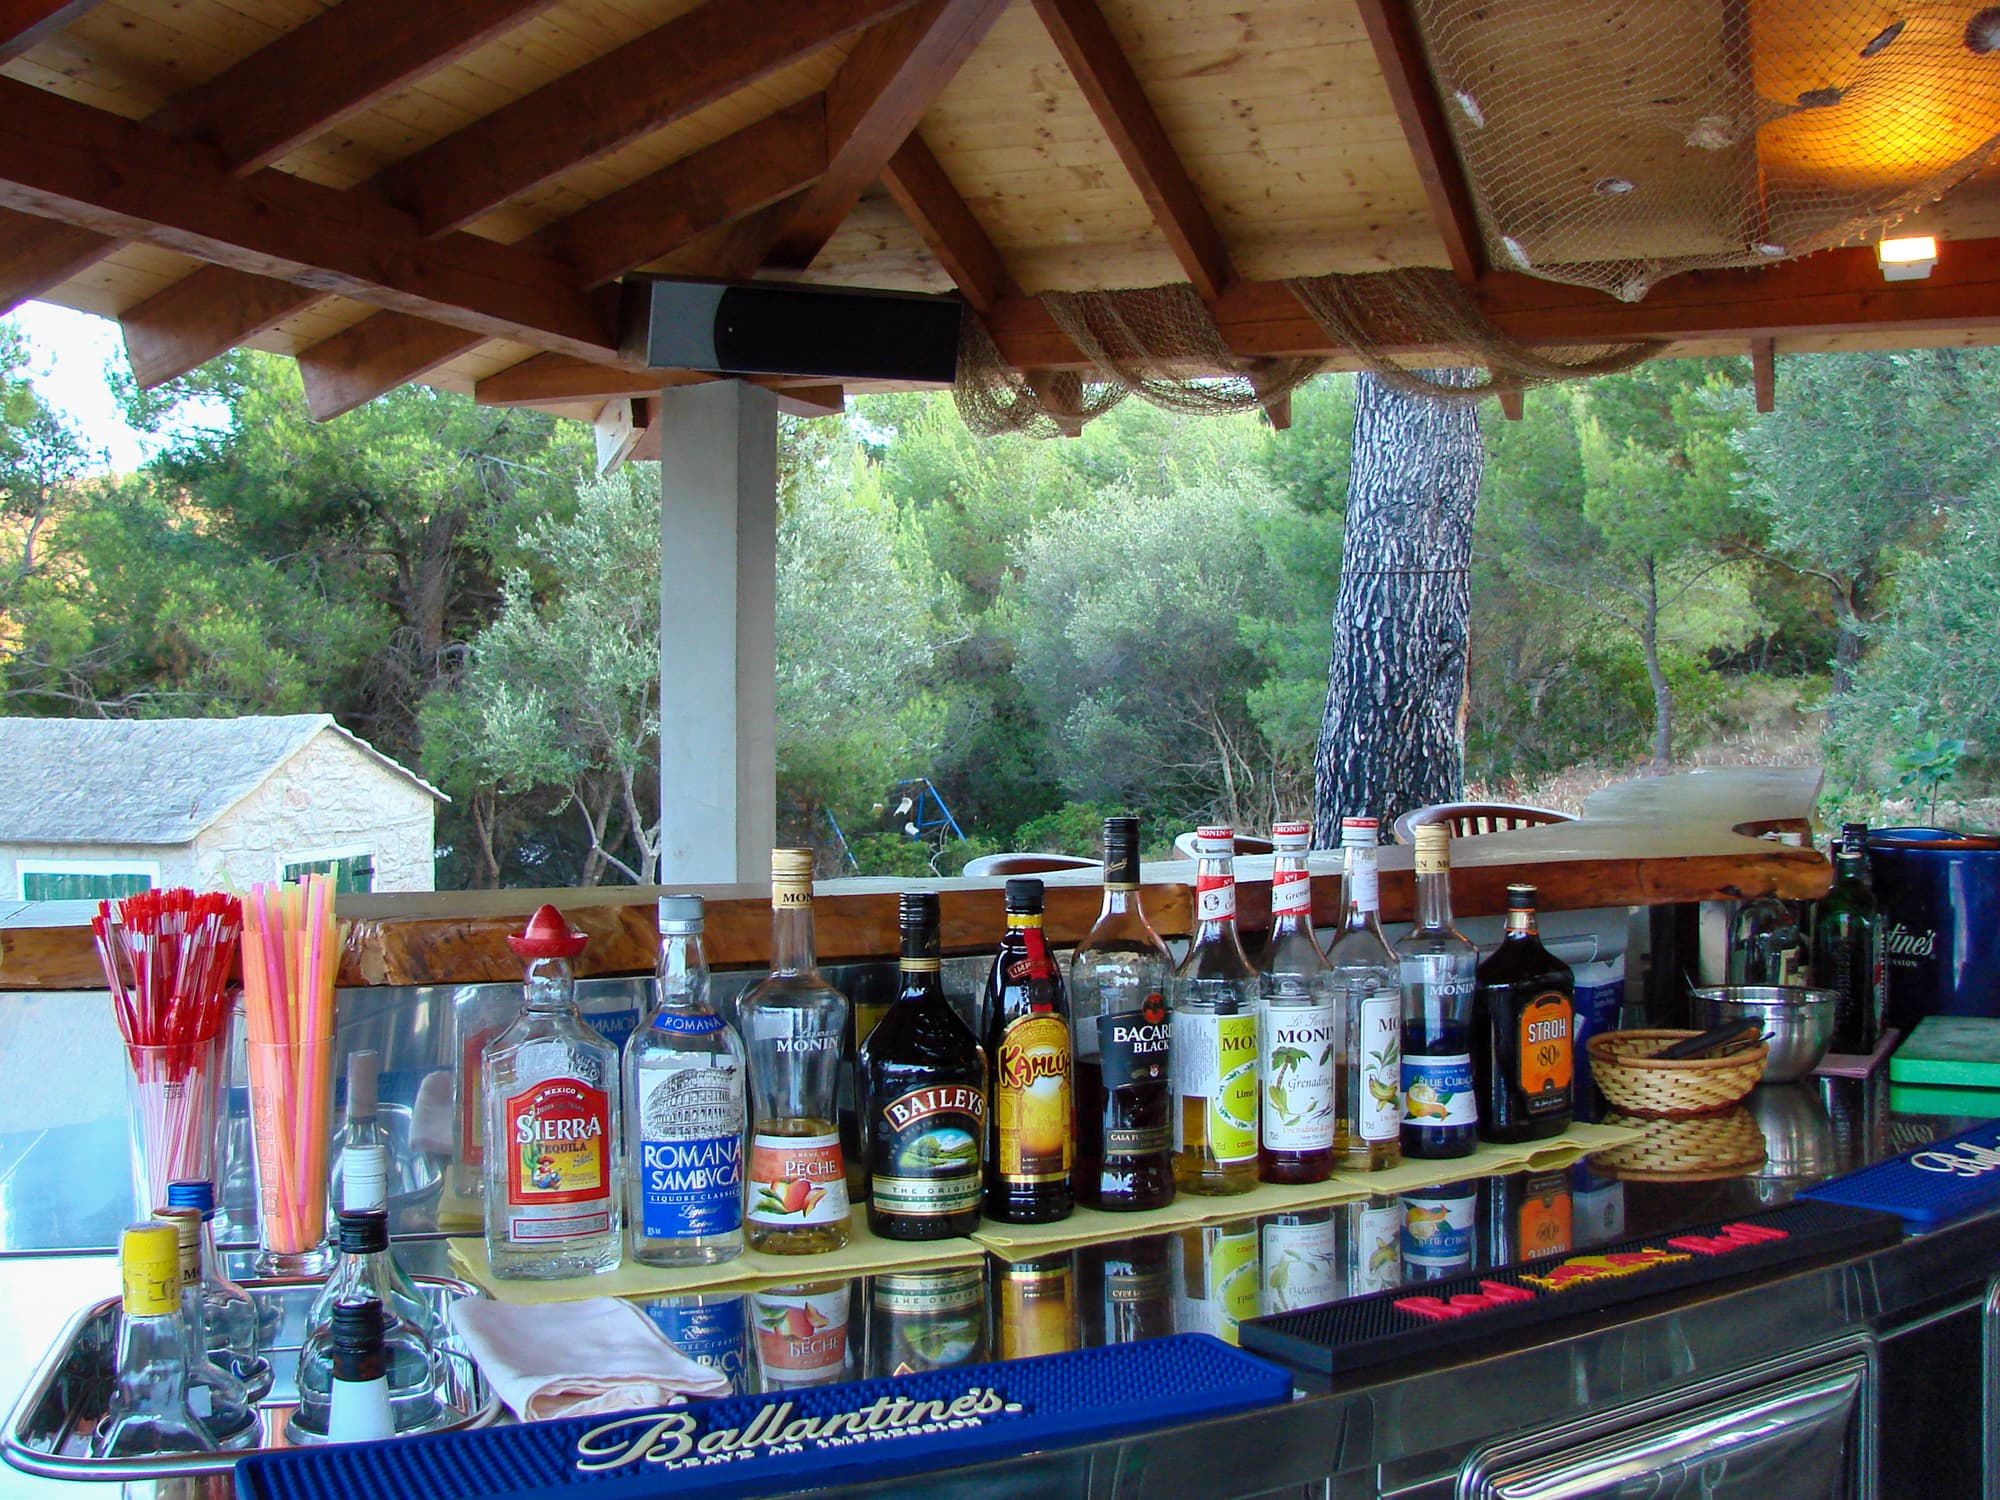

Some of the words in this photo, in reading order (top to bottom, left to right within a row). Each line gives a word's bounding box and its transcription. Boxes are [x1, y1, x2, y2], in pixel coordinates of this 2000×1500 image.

[664, 1017, 722, 1031] ROMANA
[1528, 1018, 1566, 1043] STROH
[777, 1036, 839, 1052] MONIN
[1133, 1040, 1169, 1053] BLACK
[544, 1087, 576, 1097] MEXICO
[890, 1089, 985, 1124] BAILEYS
[516, 1109, 602, 1145] SIERRA
[537, 1142, 587, 1154] TEQUILA
[644, 1138, 741, 1169] ROMANA
[651, 1164, 740, 1191] SAMBVCA
[651, 1194, 696, 1202] LIQUORE
[892, 1186, 918, 1195] THE
[576, 1388, 1003, 1471] Ballantine's
